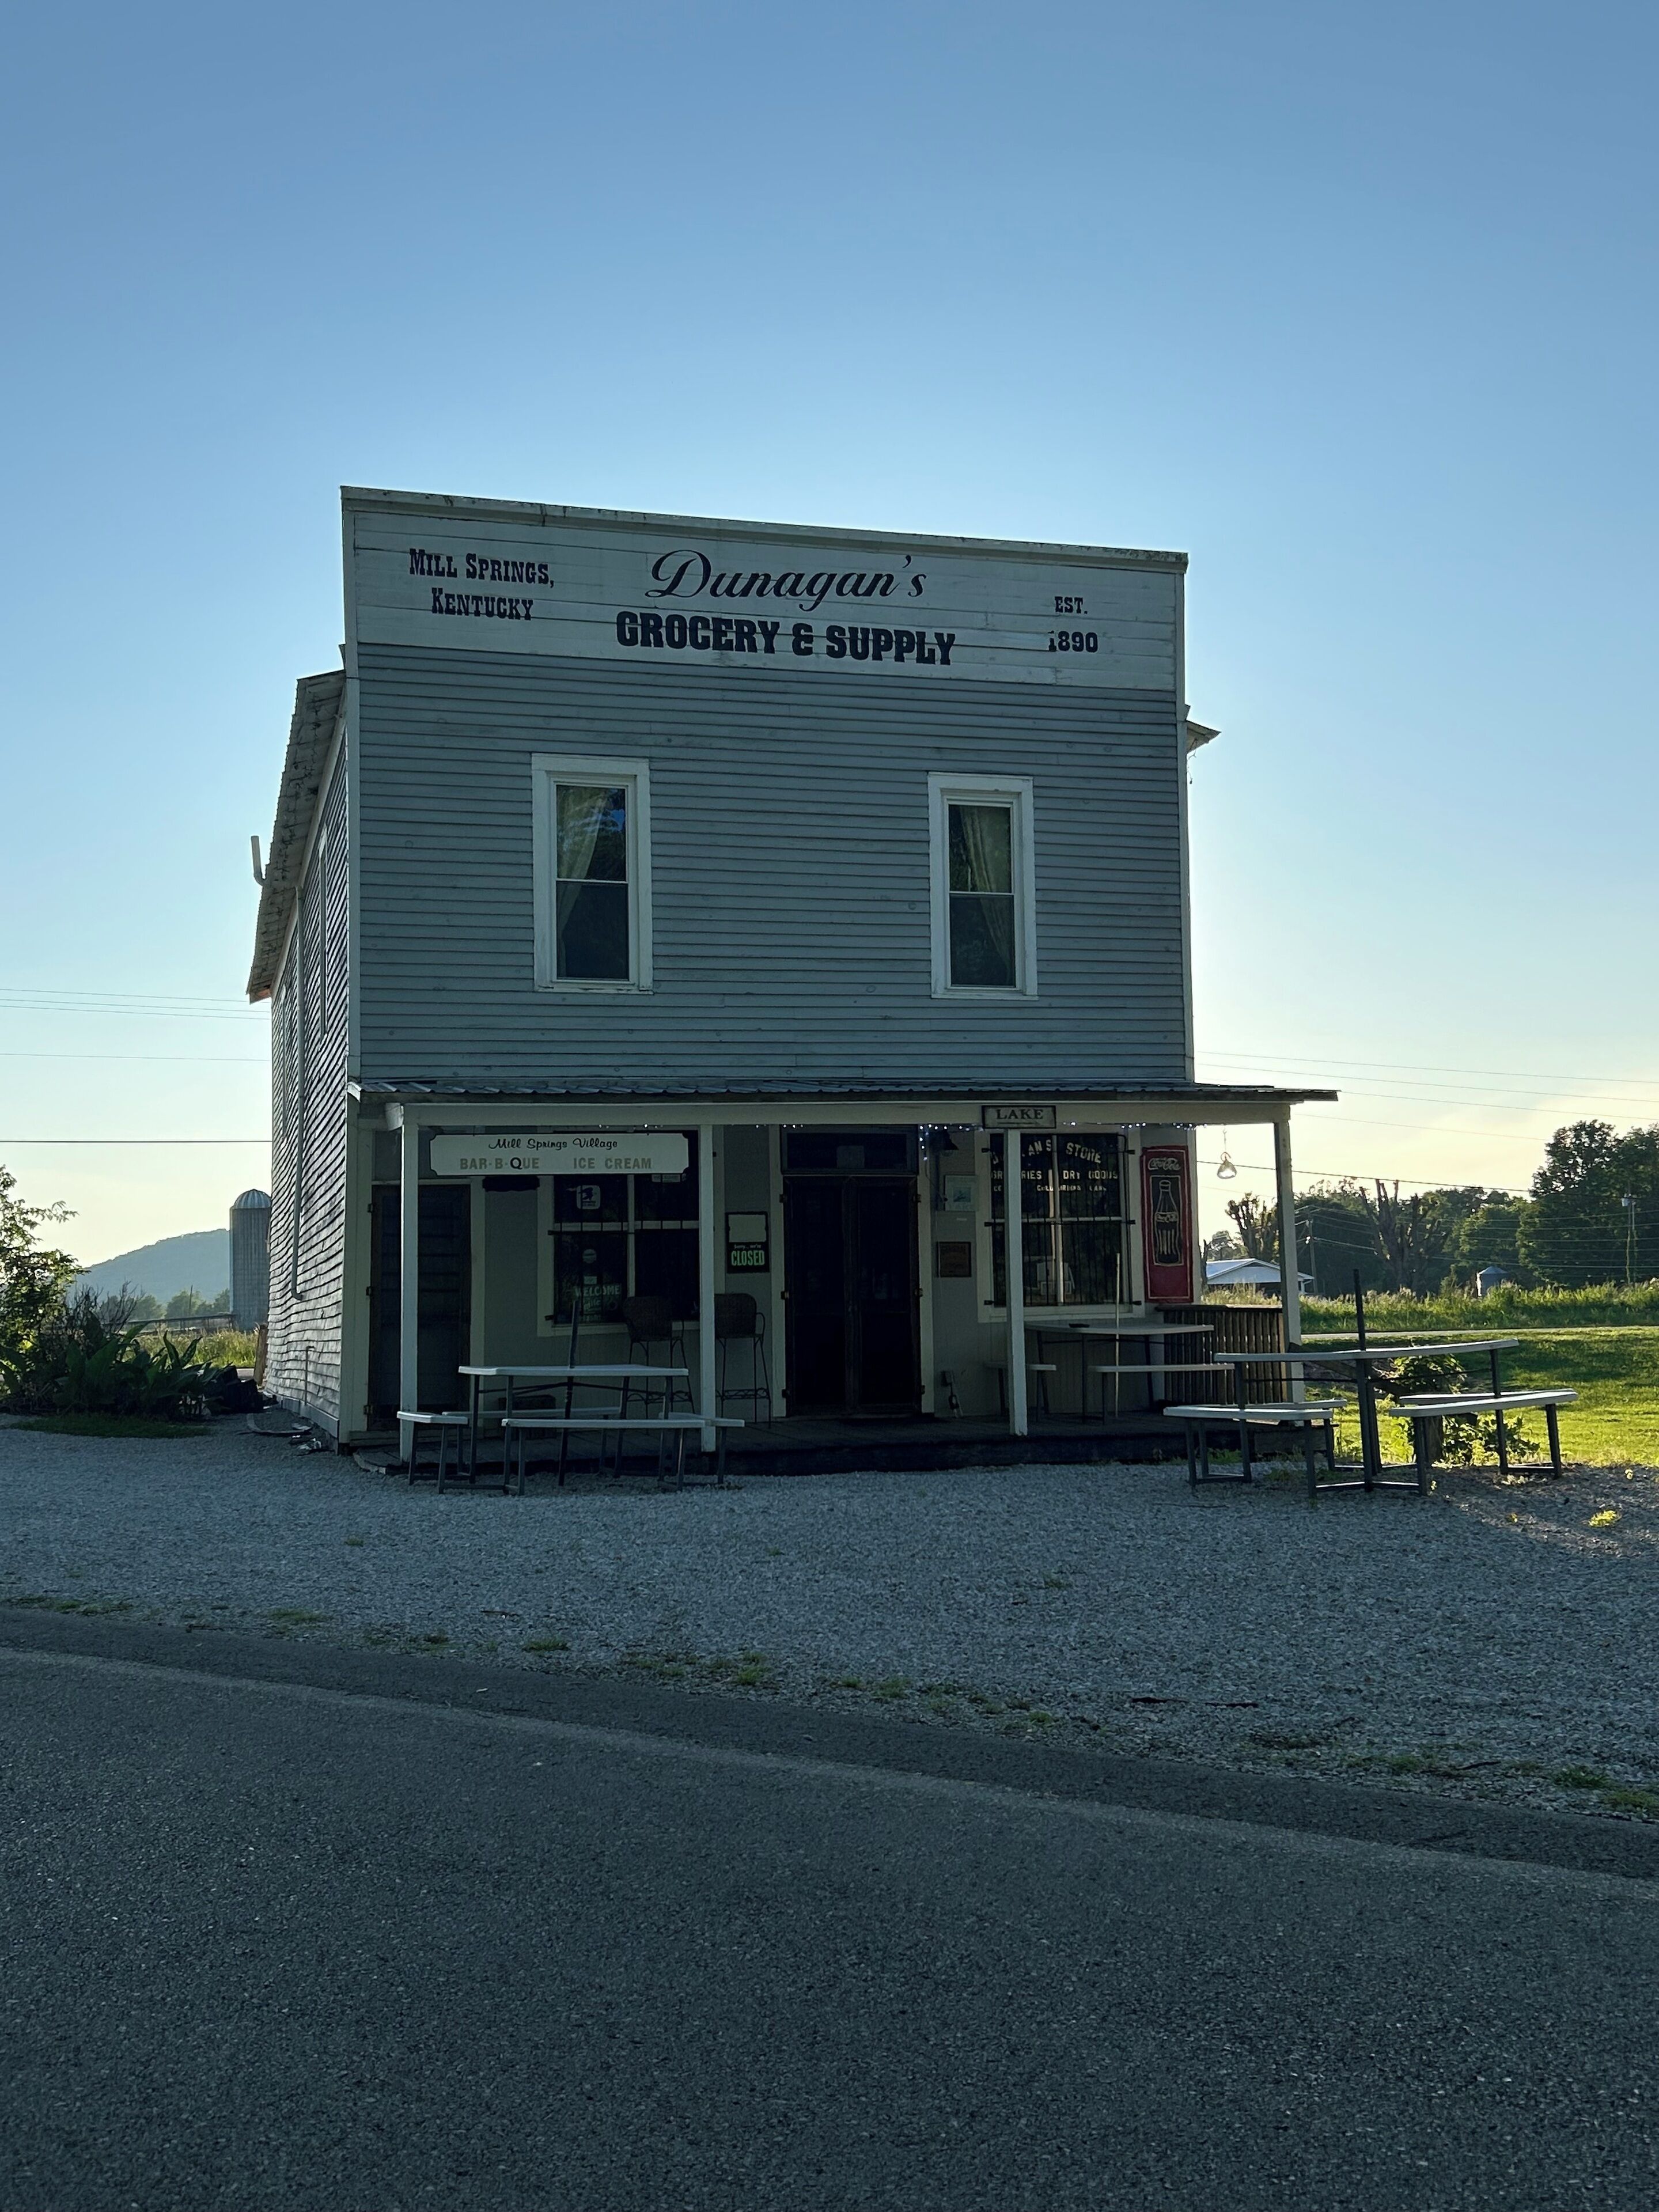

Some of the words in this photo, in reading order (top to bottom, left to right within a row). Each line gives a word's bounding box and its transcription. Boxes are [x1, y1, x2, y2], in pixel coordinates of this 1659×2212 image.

[410, 548, 457, 577] MILL
[465, 553, 555, 588] SPRINGS,
[645, 549, 927, 611] Dunagan's
[431, 588, 534, 621] KENTUCKY
[1054, 596, 1088, 614] EST.
[616, 610, 780, 654] GROCERY
[791, 623, 814, 656] &
[826, 625, 956, 665] SUPPLY
[1048, 631, 1099, 653] 1890
[996, 1109, 1044, 1119] LAKE
[488, 1138, 521, 1149] Mill
[527, 1138, 567, 1150] Springs
[573, 1138, 618, 1149] Village
[1066, 1142, 1101, 1164] STORE
[574, 1158, 596, 1169] ICE
[605, 1157, 652, 1169] CREAM
[731, 1250, 765, 1266] CLOSED
